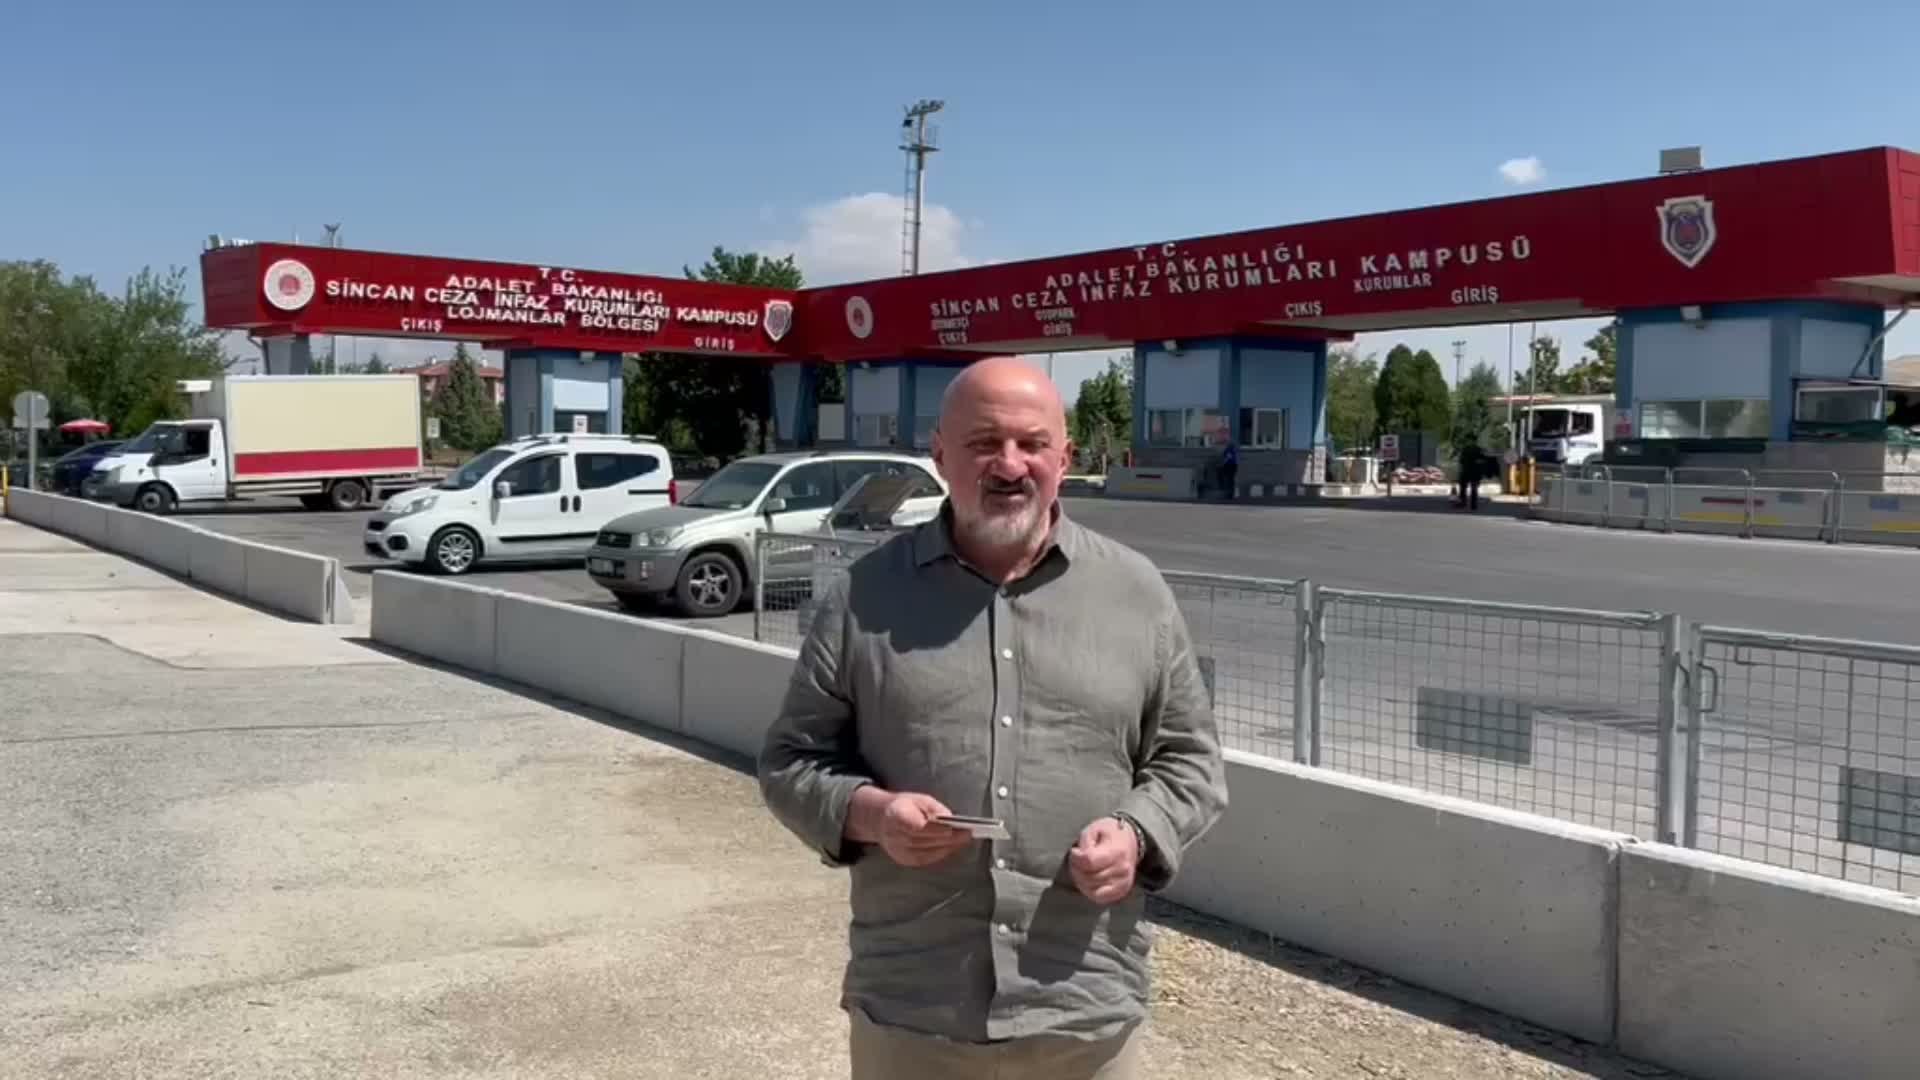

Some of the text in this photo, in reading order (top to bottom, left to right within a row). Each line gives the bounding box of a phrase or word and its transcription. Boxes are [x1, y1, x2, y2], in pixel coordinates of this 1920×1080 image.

[930, 235, 1531, 317] SİNCAN CEZA İNFAZ KURUMLARI KAMPUSÜ
[1045, 243, 1304, 289] ADALET BAKANLIĞI
[445, 274, 663, 304] ADALET BAKANLIĞI
[1353, 272, 1433, 294] KURUMLAR
[1451, 284, 1499, 305] GİRİŞ
[326, 277, 759, 326] SİNCAN CEZA İNFAZ KURUMLARI KAMPUSÜ
[1285, 300, 1323, 319] ÇIKIŞ
[401, 316, 443, 333] ÇIKIŞ
[447, 305, 660, 333] LOJMANLAR BÖLGESİ
